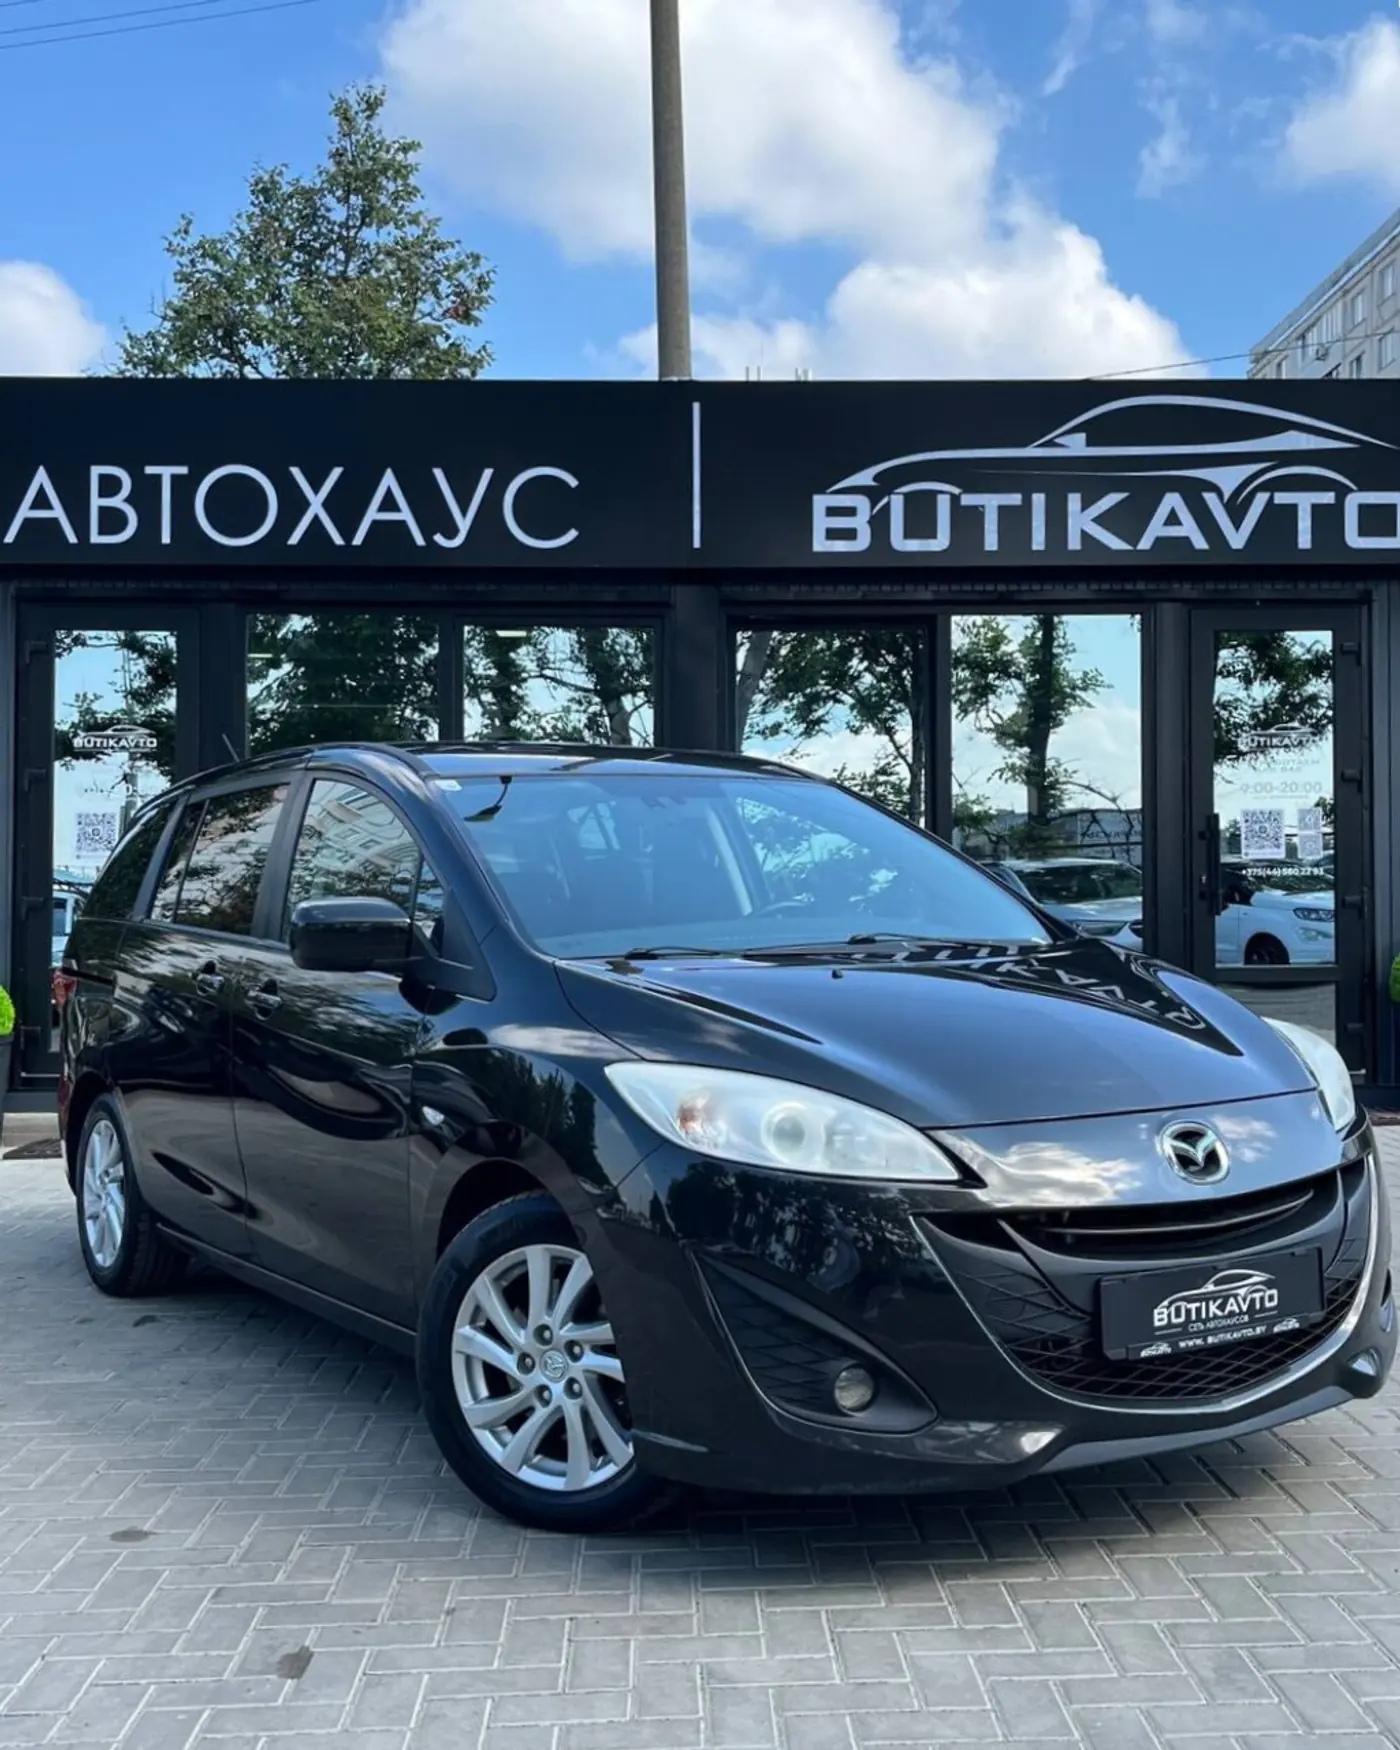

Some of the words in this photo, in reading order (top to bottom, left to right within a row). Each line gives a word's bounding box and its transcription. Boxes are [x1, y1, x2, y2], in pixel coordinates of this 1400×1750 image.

[3, 464, 579, 549] АВТОХАУС
[812, 490, 1400, 553] BUTIKAVTO
[73, 736, 158, 749] BUTIKAVTO
[1153, 1288, 1278, 1327] BUTIKAVTO
